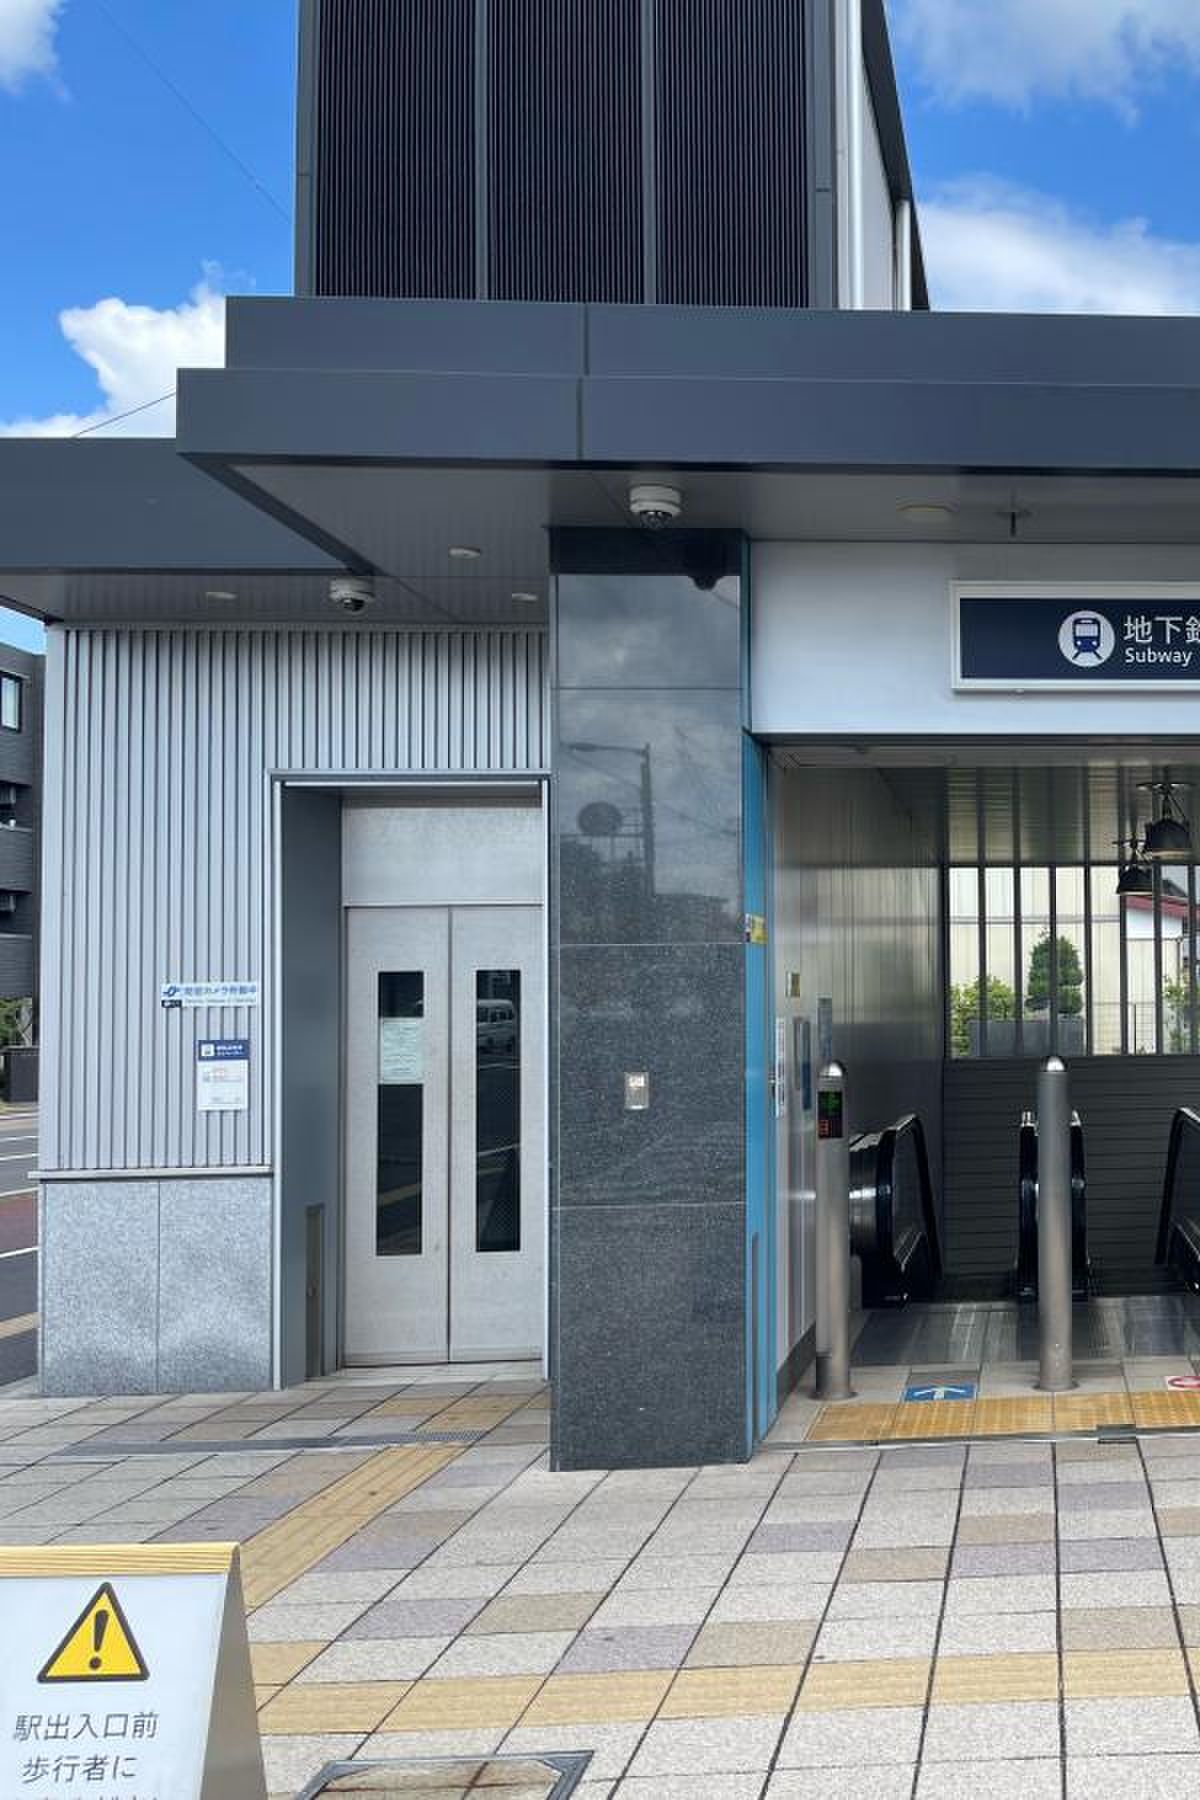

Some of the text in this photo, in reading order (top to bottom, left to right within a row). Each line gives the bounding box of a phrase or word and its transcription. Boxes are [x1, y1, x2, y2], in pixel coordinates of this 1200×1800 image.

[1125, 647, 1193, 667] Subway
[13, 1711, 160, 1742] 駅出入口前
[22, 1754, 139, 1785] 歩行者に
